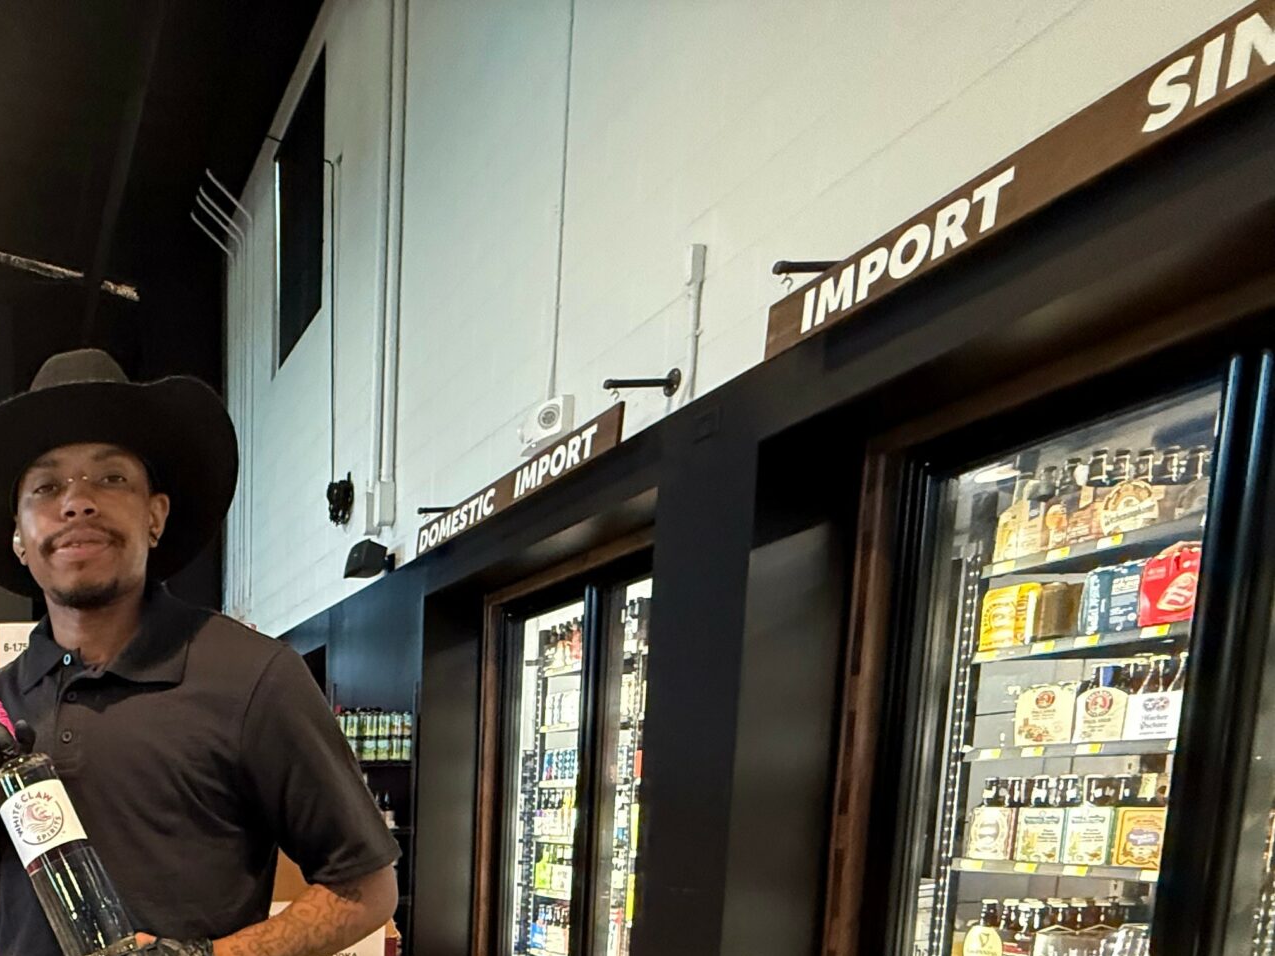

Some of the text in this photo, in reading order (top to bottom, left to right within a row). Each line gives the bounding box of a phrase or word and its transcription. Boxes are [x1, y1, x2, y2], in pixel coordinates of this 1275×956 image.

[800, 165, 1016, 335] IMPORT
[419, 423, 598, 554] DOMESTIC IMPORT
[12, 791, 54, 838] WHITE CLAW
[36, 816, 62, 842] SPIRITS
